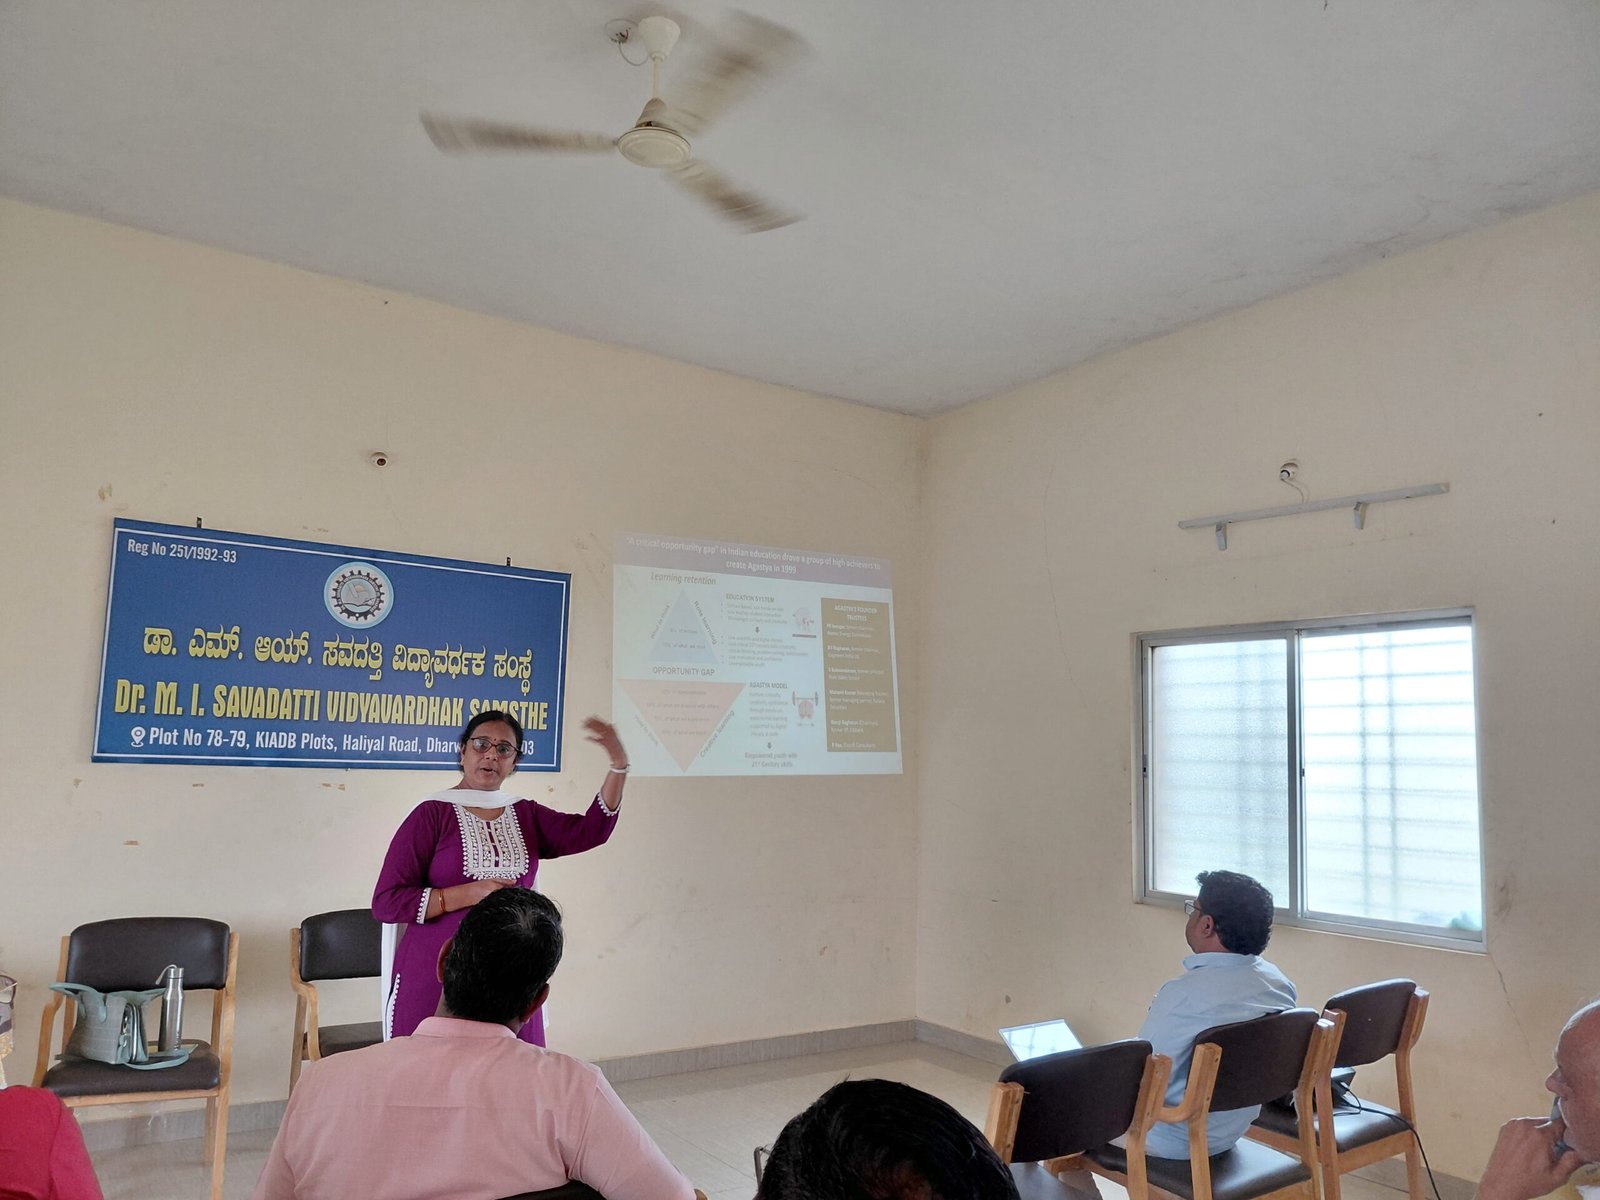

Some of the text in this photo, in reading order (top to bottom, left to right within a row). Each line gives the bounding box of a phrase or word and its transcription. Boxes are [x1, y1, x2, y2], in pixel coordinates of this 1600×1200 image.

[128, 539, 237, 563] Reg No 251/1992-93
[661, 541, 701, 553] opportunity
[721, 547, 727, 555] in
[728, 548, 749, 557] Indian
[750, 550, 781, 561] education
[782, 552, 800, 562] drove
[806, 557, 824, 566] group
[825, 557, 832, 565] of
[833, 558, 845, 568] high
[650, 571, 717, 585] Learning retention
[726, 561, 797, 574] create Agastya in 1999
[726, 593, 775, 603] EDUCATION SYSTEM
[143, 627, 177, 655] ಡಾ.
[322, 634, 383, 681] ಸವದತ್ತಿ
[392, 642, 486, 688] ವಿದ್ಯಾವರ್ಧಕ
[494, 647, 532, 696] ಸಂಸ್ಥೆ
[652, 666, 715, 676] OPPORTUNITY GAP
[114, 679, 146, 714] Dr.
[154, 681, 183, 716] M.
[191, 683, 205, 717] I.
[213, 684, 321, 721] SAVADATTI
[326, 690, 464, 727] VIDYAVARDHAK
[149, 727, 178, 746] Plot
[183, 728, 202, 746] No
[207, 730, 250, 750] 78-79,
[256, 731, 297, 749] KIADB
[301, 733, 338, 752] Plots,
[343, 734, 385, 754] Haliyal
[389, 736, 422, 755] Road,
[427, 737, 461, 753] Dharw
